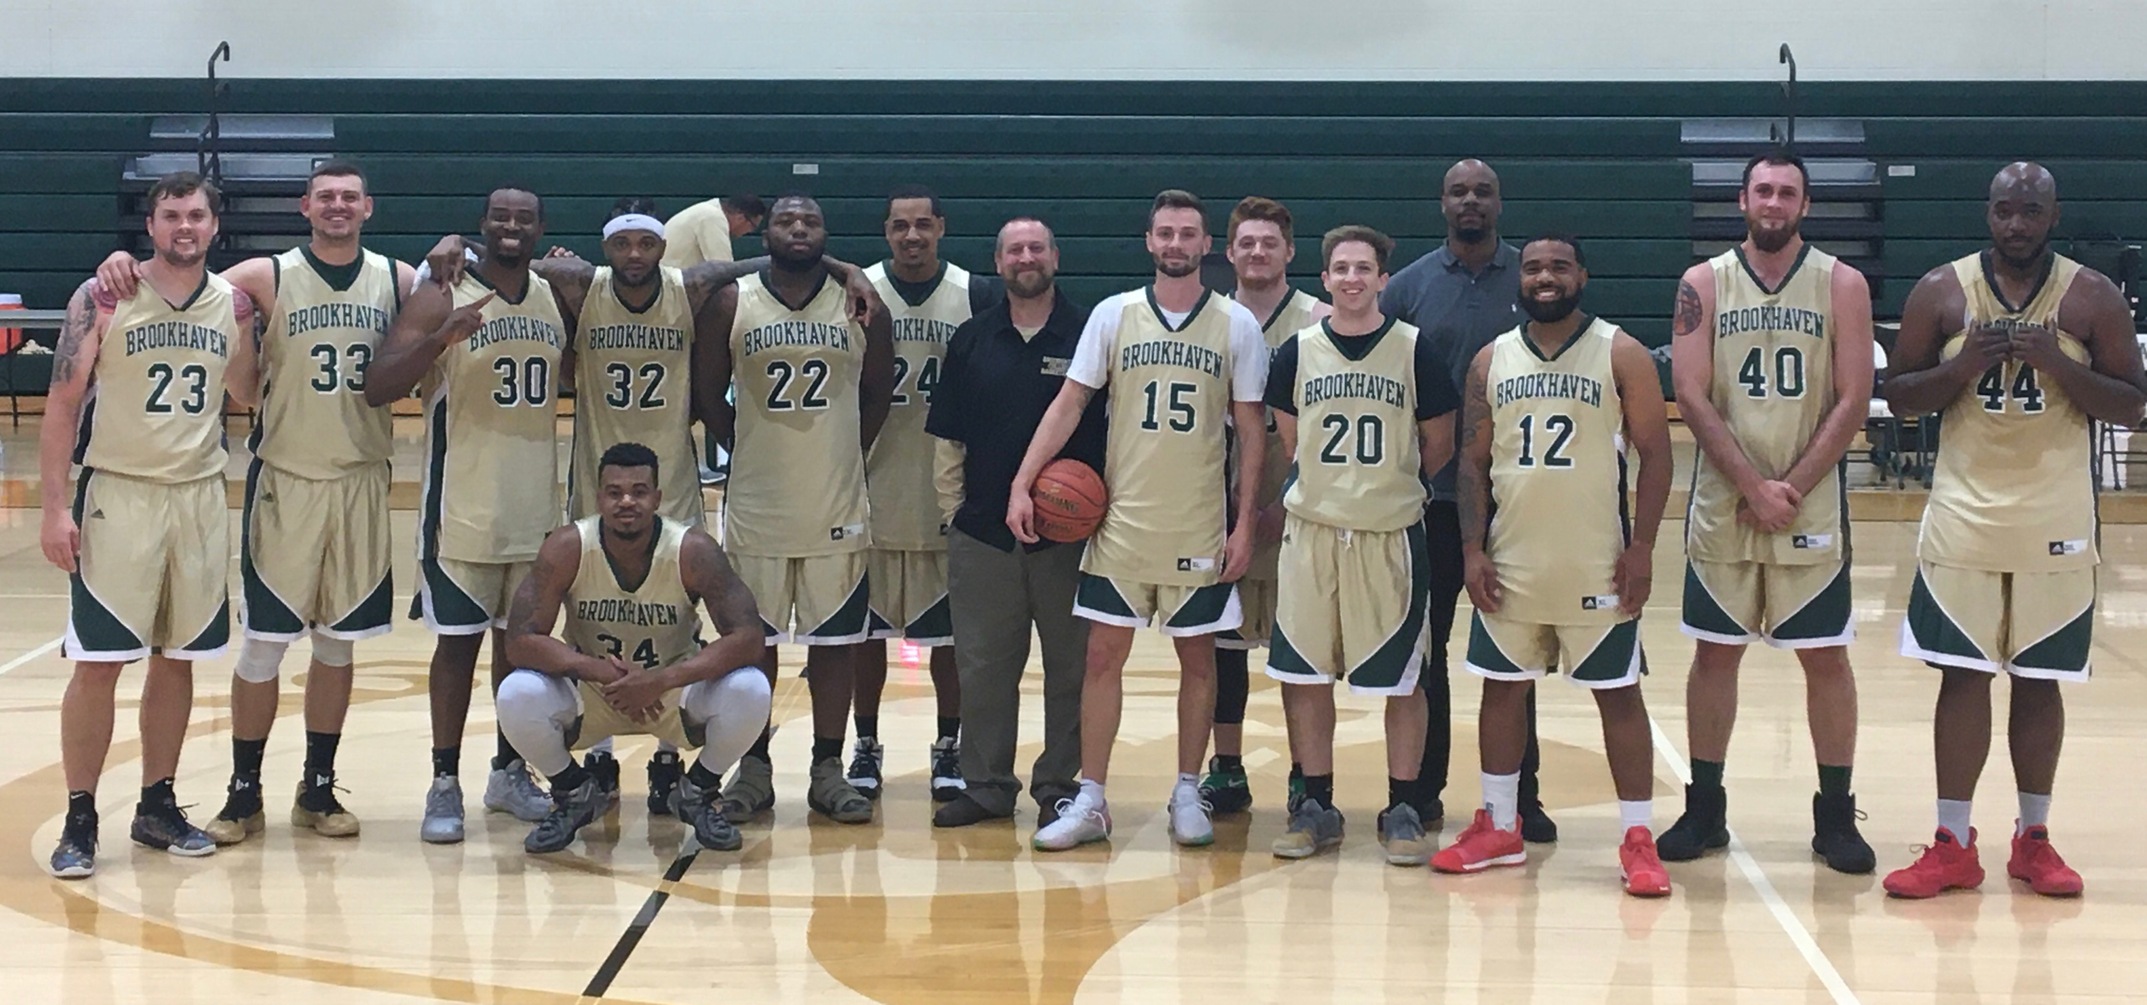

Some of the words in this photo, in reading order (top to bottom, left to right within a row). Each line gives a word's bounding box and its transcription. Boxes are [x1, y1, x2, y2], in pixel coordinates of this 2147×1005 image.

[126, 321, 228, 358] BROOKHAVEN
[589, 323, 684, 351] BROOKHAVEN
[744, 321, 849, 356] BROOKHAVEN
[1719, 306, 1824, 340] BROOKHAVEN
[310, 342, 373, 394] 33
[492, 355, 549, 408] 30
[766, 357, 831, 412] 22
[889, 354, 941, 406] 24
[1121, 340, 1223, 379] BROOKHAVEN
[1738, 345, 1807, 400] 40
[145, 362, 209, 415] 23
[605, 361, 668, 411] 32
[1140, 379, 1199, 433] 15
[1304, 372, 1406, 410] BROOKHAVEN
[1496, 373, 1602, 409] BROOKHAVEN
[1976, 360, 2046, 414] 44
[1320, 413, 1386, 465] 20
[1517, 413, 1576, 469] 12
[577, 599, 678, 627] BROOKHAVEN
[596, 632, 661, 670] 34
